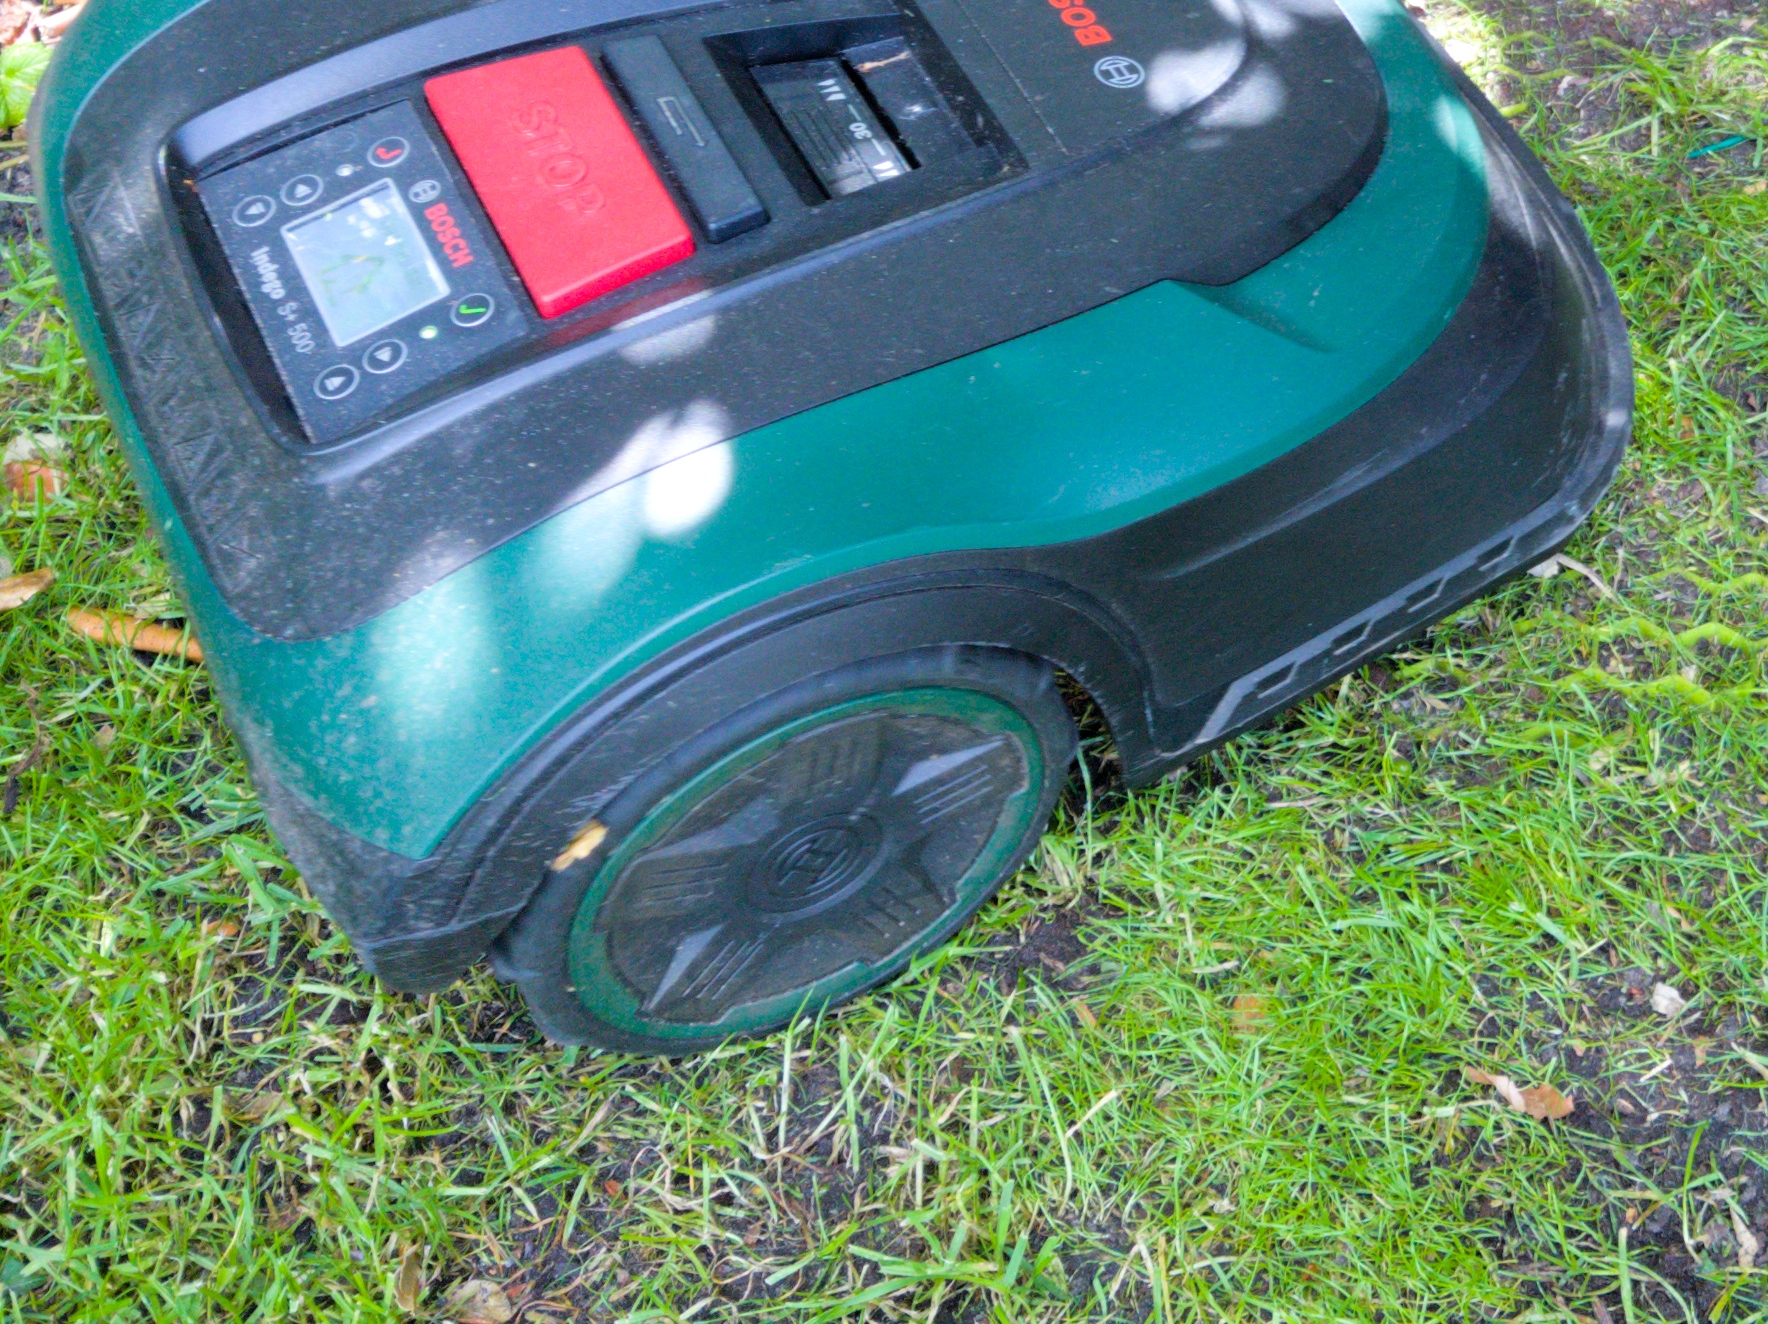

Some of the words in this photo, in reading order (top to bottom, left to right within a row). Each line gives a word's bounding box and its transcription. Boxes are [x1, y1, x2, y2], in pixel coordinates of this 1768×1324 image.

[511, 101, 606, 215] STOP
[849, 122, 872, 139] 30
[424, 202, 474, 267] BOSCH
[249, 246, 286, 299] Indego
[287, 323, 315, 353] 500
